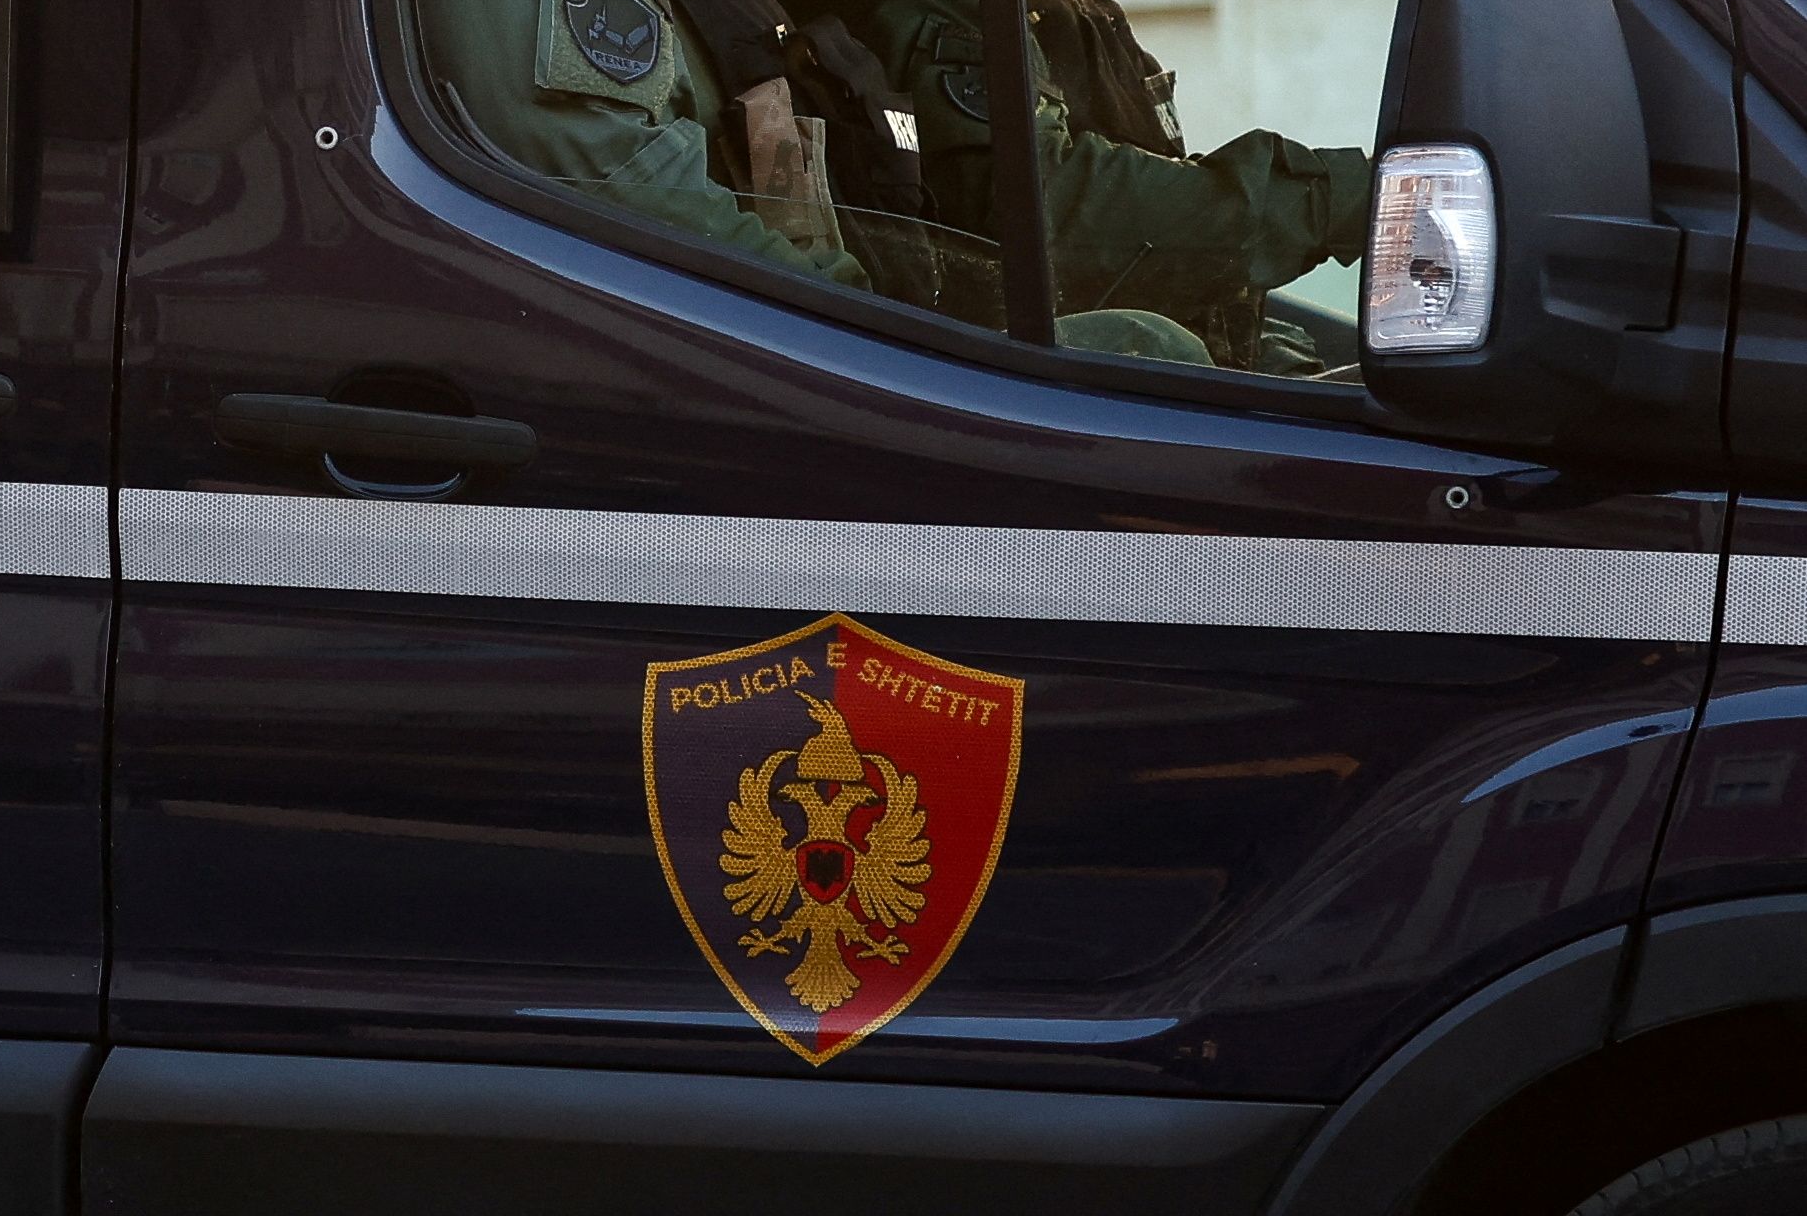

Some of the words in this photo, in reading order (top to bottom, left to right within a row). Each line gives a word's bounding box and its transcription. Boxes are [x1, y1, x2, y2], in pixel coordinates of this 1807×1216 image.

[596, 53, 642, 70] RENEA
[671, 656, 816, 713] POLICIA
[827, 643, 848, 667] E
[858, 658, 1000, 726] SHTETIT
